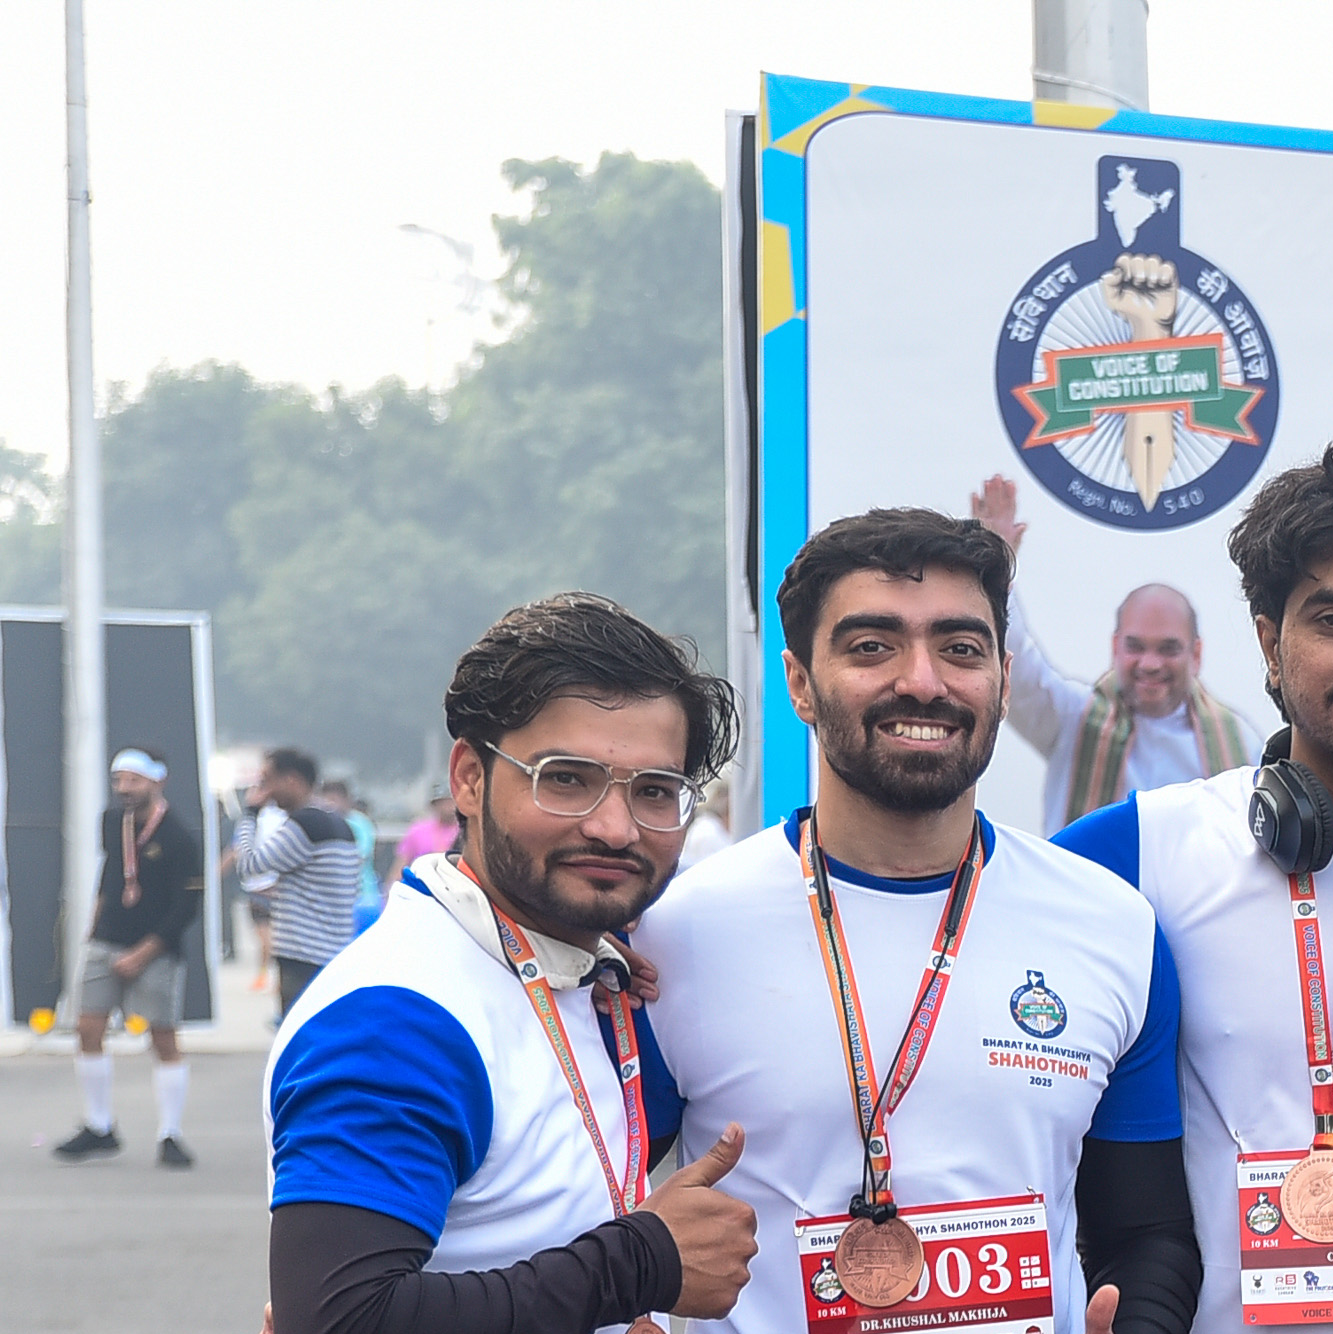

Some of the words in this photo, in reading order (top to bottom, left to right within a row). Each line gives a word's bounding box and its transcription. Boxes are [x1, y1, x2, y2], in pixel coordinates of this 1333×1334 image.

[1197, 268, 1228, 302] की
[1092, 356, 1150, 377] VOICE
[1156, 353, 1181, 373] OF
[1069, 371, 1209, 401] CONSTITUTION
[1067, 479, 1106, 509] Regn.
[1109, 498, 1138, 517] No.
[1303, 925, 1317, 958] VOICE
[1306, 962, 1319, 976] OF
[534, 987, 550, 1013] 2025
[918, 1011, 931, 1029] OF
[1309, 978, 1327, 1060] CONSTITUTION
[982, 1038, 1024, 1050] BHARAT
[1025, 1042, 1039, 1052] KA
[1041, 1045, 1091, 1063] BHAVISHYA
[855, 1065, 867, 1082] KA
[988, 1052, 1088, 1080] SHAHOTHON
[1029, 1076, 1053, 1087] 2025
[629, 1122, 640, 1136] OF
[940, 1218, 1008, 1234] SHAHOTHON
[1010, 1215, 1036, 1226] 2025
[1250, 1240, 1261, 1248] 10
[1263, 1239, 1279, 1248] KM
[817, 1309, 828, 1318] 10
[830, 1307, 847, 1317] KM
[860, 1315, 946, 1332] DR.KHUSHAL
[949, 1306, 1008, 1323] MAKHIJA
[1302, 1308, 1332, 1318] VOICE
